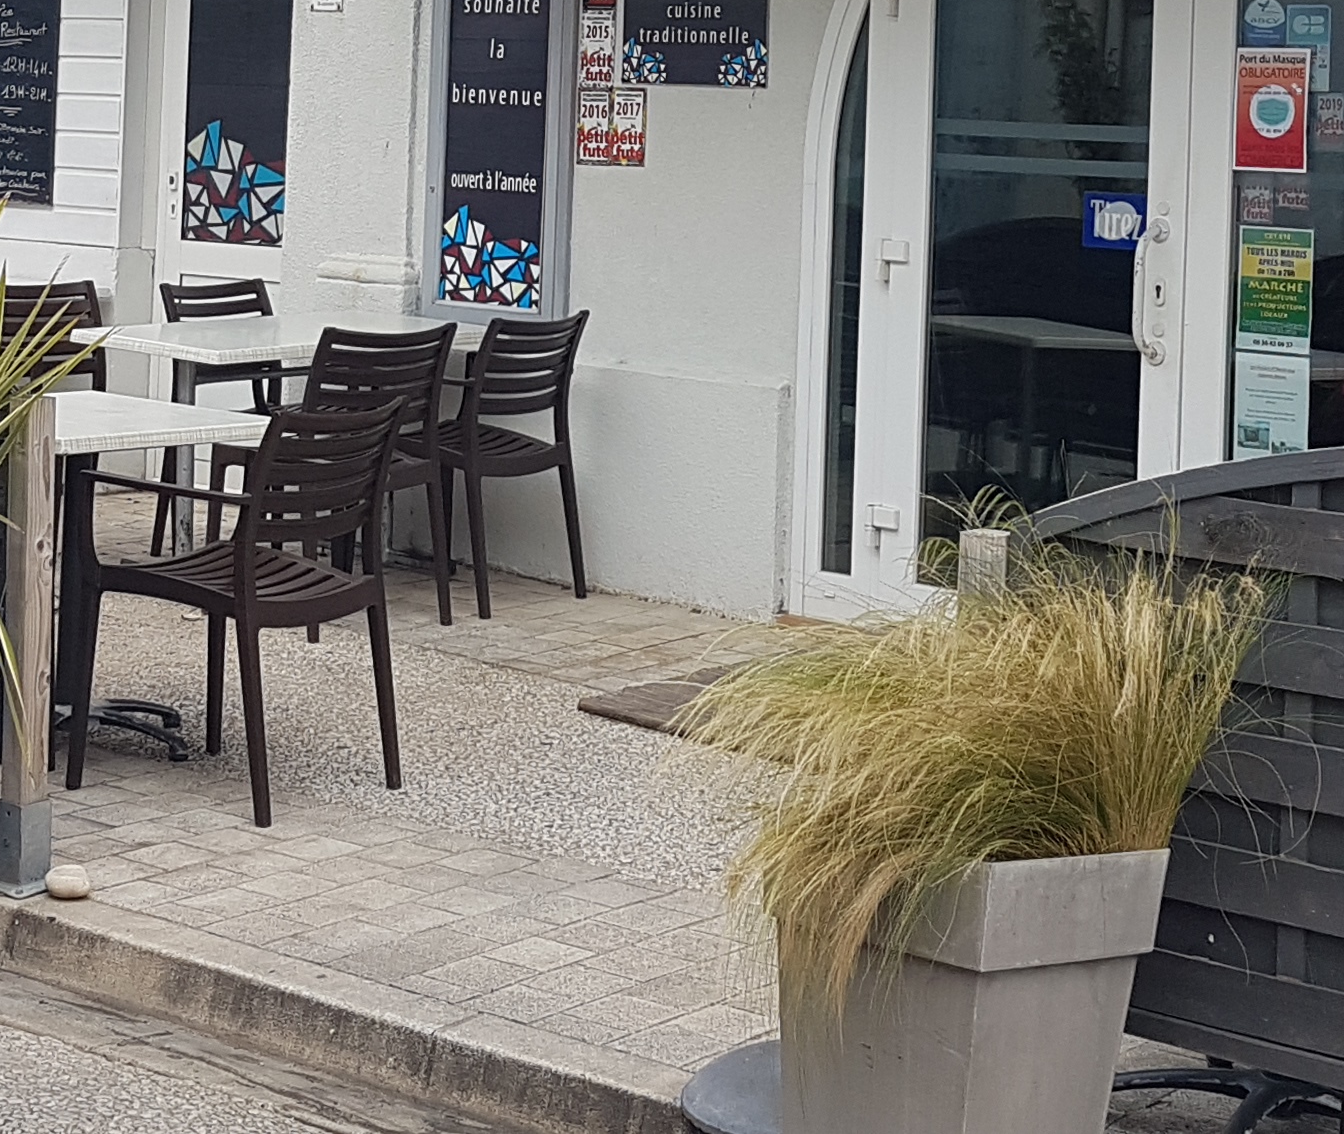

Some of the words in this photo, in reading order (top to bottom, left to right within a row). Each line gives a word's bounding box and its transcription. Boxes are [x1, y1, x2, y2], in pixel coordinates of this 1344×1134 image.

[666, 1, 722, 18] cuisine
[585, 24, 610, 40] 2015
[638, 26, 750, 44] traditionnelle
[489, 37, 505, 59] la
[580, 51, 615, 70] petit
[1239, 53, 1258, 65] Port
[1259, 54, 1270, 64] du
[1272, 55, 1307, 66] Masque
[1239, 66, 1306, 80] OBLIGATOIRE
[452, 82, 543, 107] bienvenue
[581, 103, 609, 119] 2016
[616, 102, 642, 117] 2017
[1319, 97, 1344, 111] 2019
[450, 171, 484, 190] ouvert
[485, 169, 493, 190] à
[1089, 198, 1144, 241] Tirez
[1266, 248, 1279, 258] LES
[1247, 279, 1304, 294] MARCHÉ
